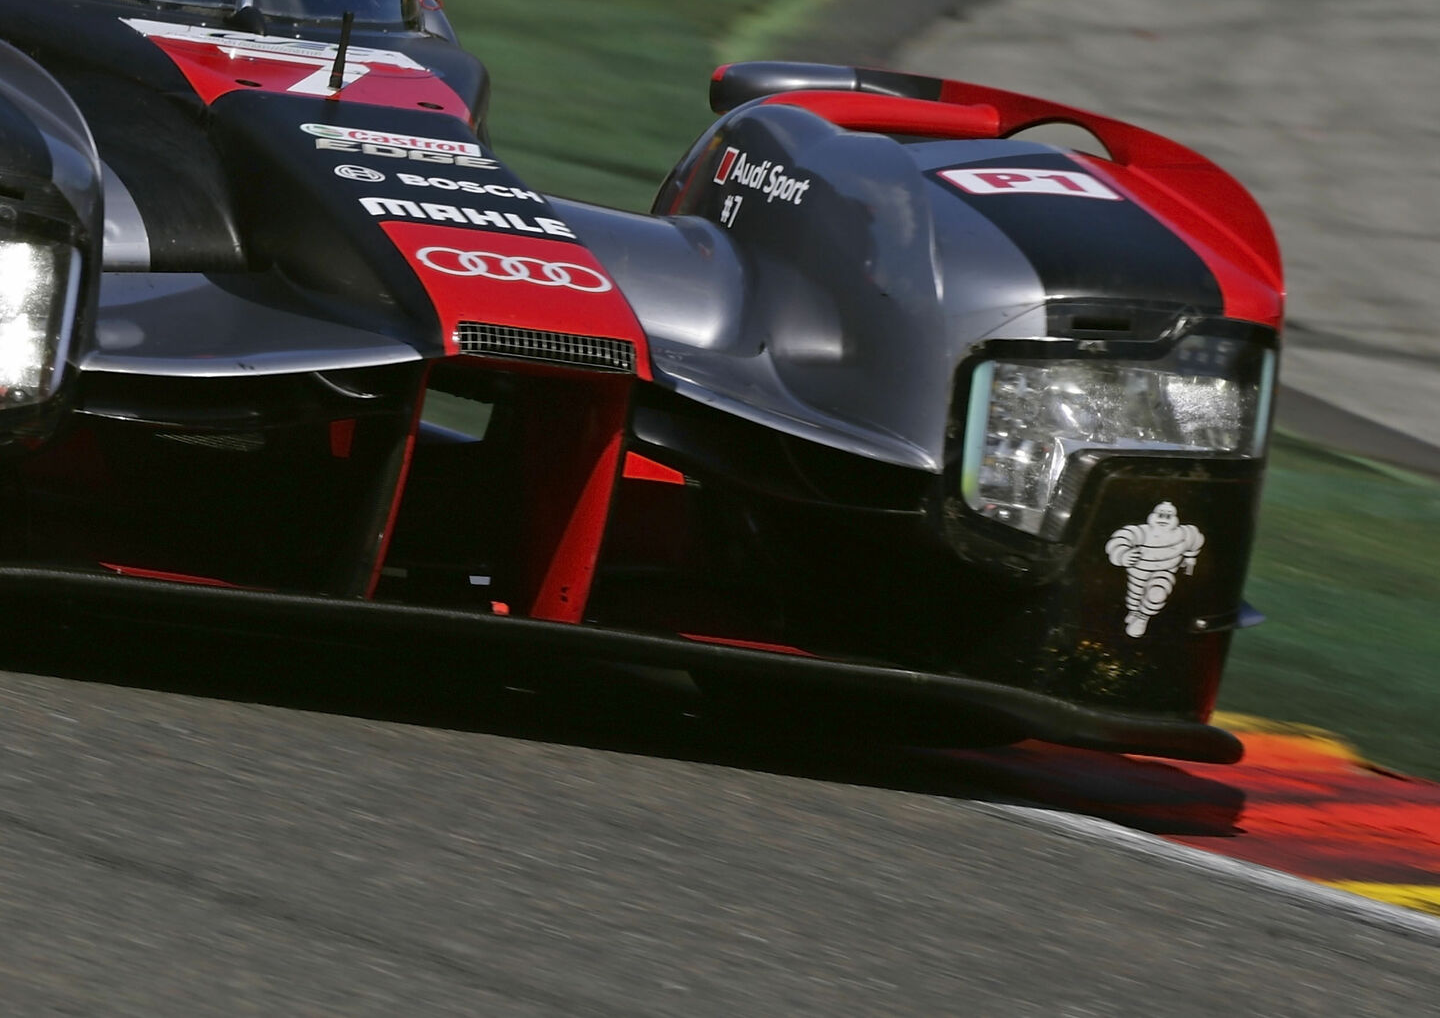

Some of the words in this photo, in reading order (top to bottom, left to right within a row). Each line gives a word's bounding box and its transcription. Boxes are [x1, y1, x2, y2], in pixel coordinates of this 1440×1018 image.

[315, 137, 502, 170] EDGE
[348, 129, 469, 154] Castrol
[396, 172, 545, 204] BOSCH
[730, 152, 772, 190] Audi
[762, 165, 810, 205] Sport
[973, 172, 1089, 193] P1
[358, 196, 578, 240] MAHLE
[720, 194, 744, 229] #7
